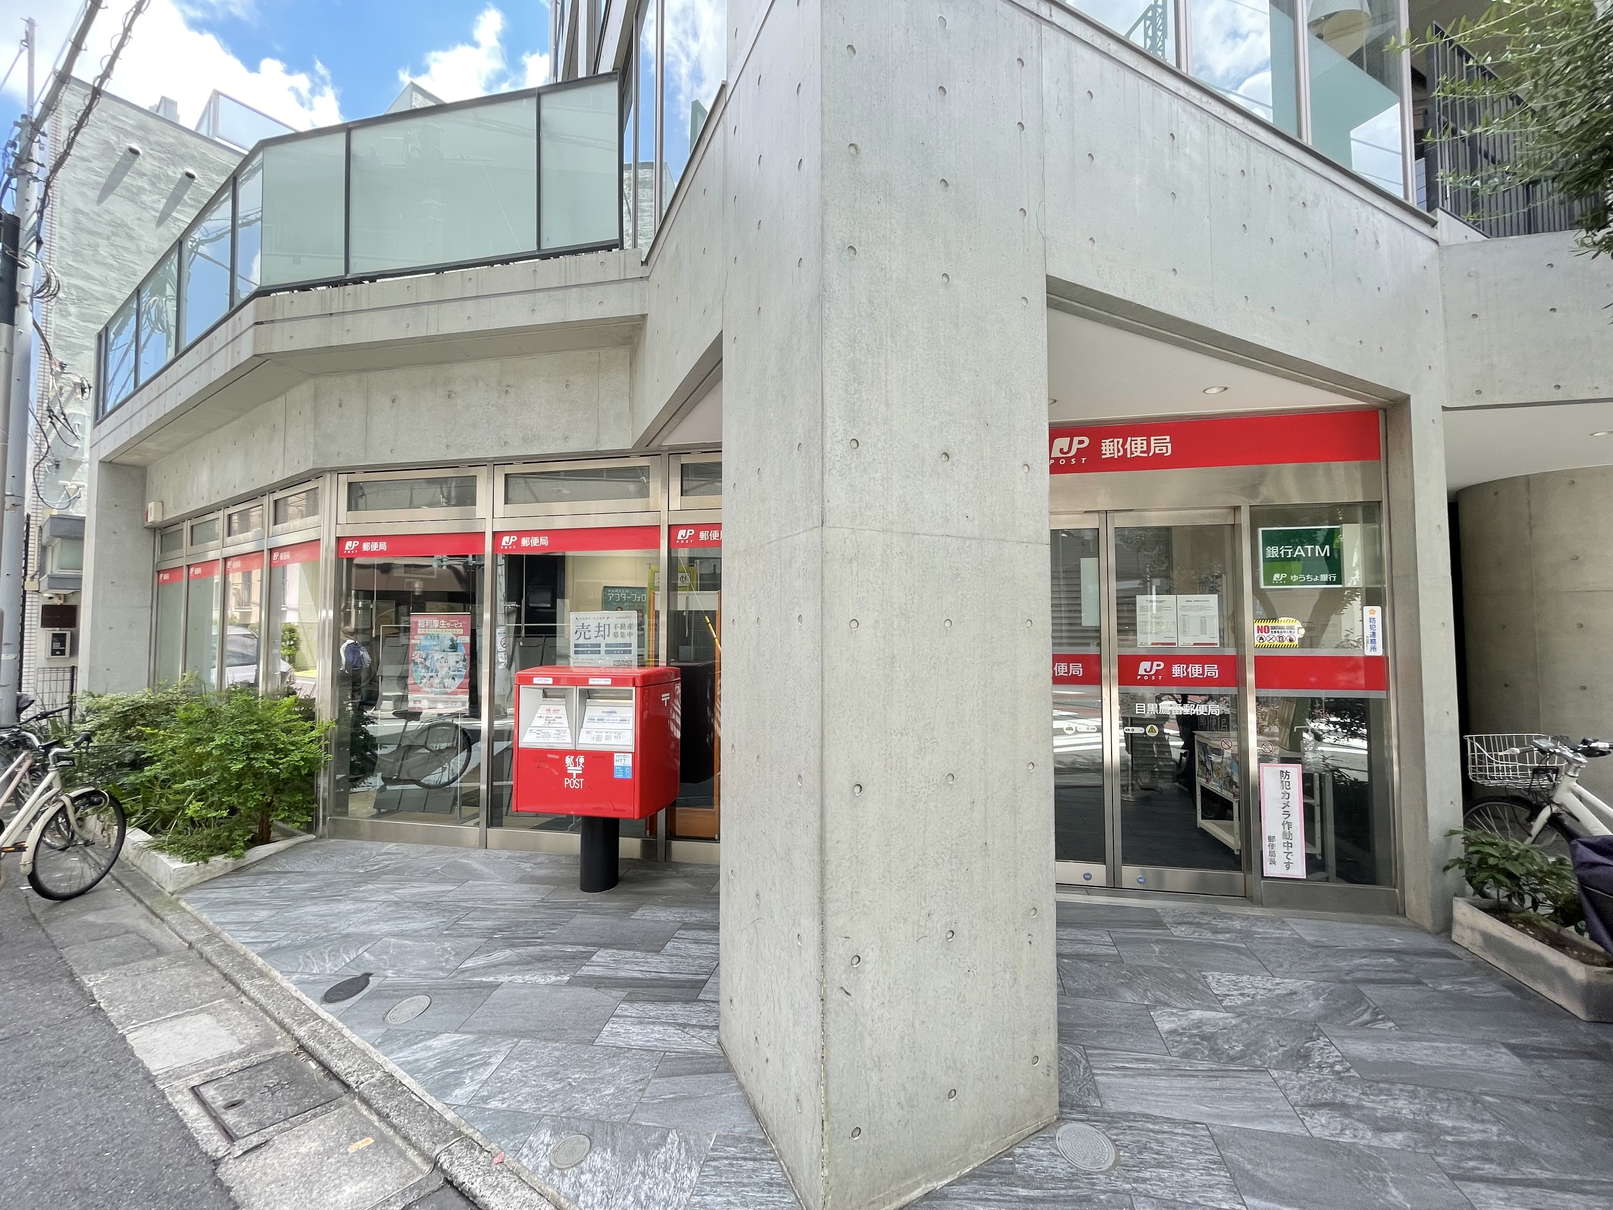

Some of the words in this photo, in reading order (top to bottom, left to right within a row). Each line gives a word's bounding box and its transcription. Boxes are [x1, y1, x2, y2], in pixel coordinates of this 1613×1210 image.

[1050, 436, 1090, 458] JP
[1101, 435, 1173, 458] 郵便局
[1049, 457, 1087, 465] POST
[521, 536, 549, 547] 郵便局
[698, 529, 722, 541] 郵便
[362, 541, 387, 552] 郵便局
[1265, 544, 1331, 558] 銀行ATM
[1290, 573, 1337, 582] ゆうちょ銀行
[575, 622, 611, 641] 売却
[1256, 625, 1270, 634] NO
[1053, 662, 1083, 677] 便局
[1138, 660, 1164, 675] JP
[1171, 663, 1219, 678] 郵便局
[564, 755, 585, 769] 郵便
[564, 777, 585, 789] POST
[1279, 769, 1295, 871] 防犯カメラ作動中です
